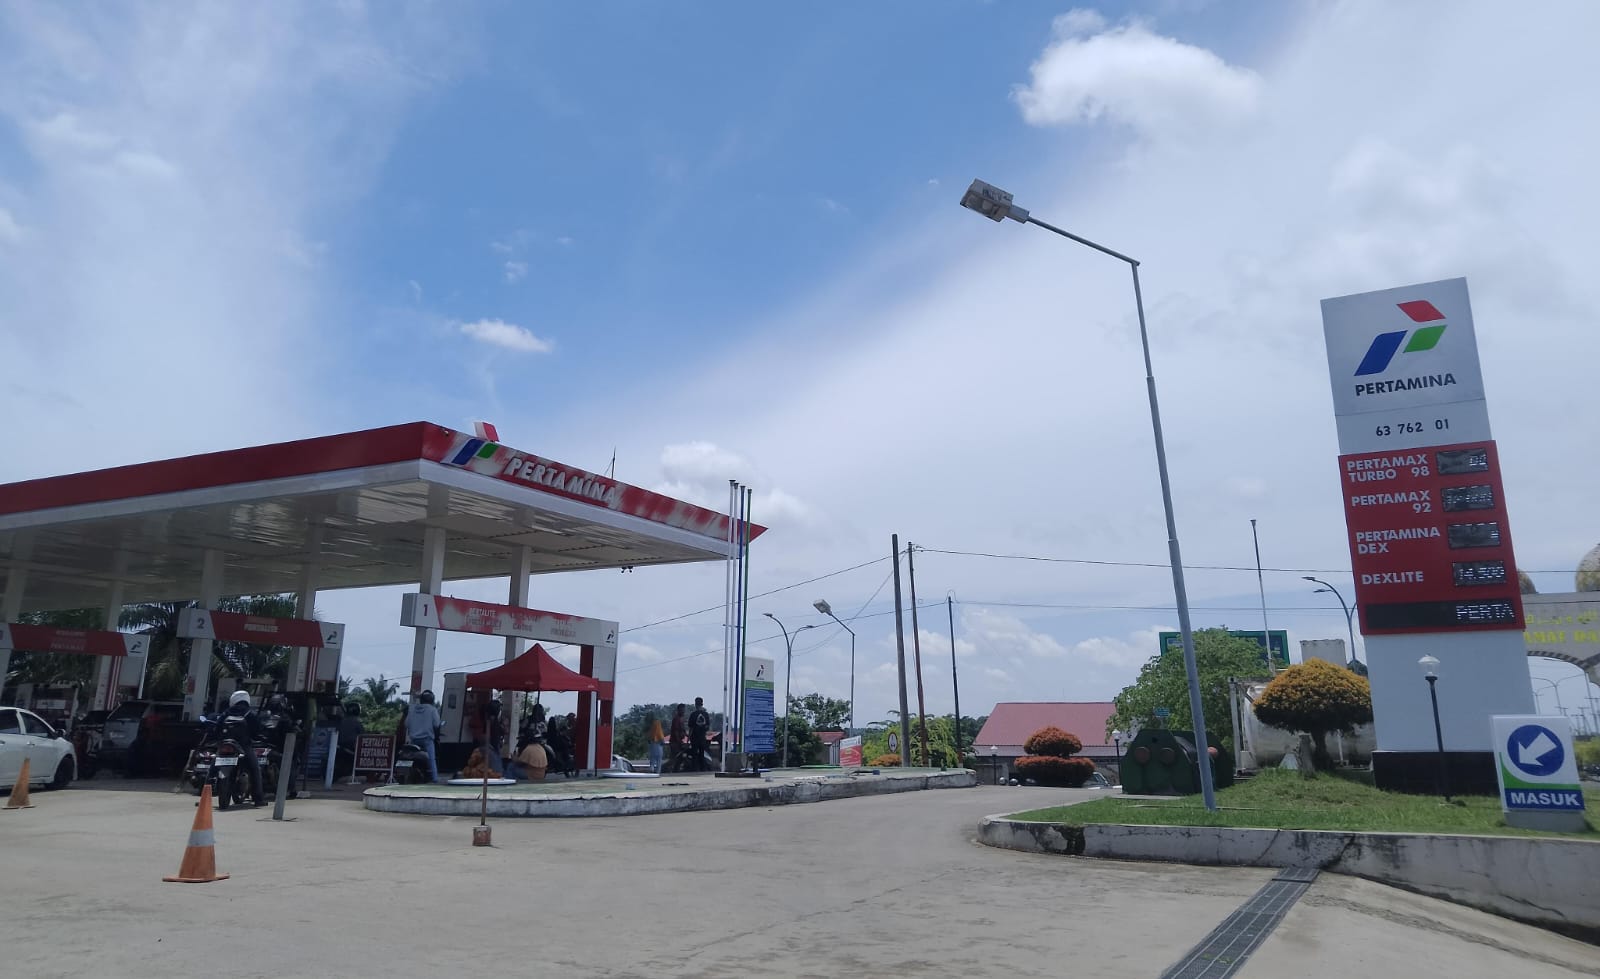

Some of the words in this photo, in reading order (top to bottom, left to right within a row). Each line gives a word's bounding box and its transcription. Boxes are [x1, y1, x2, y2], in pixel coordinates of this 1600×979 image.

[1354, 373, 1457, 397] PERTAMINA
[1375, 425, 1391, 437] 63
[1397, 422, 1424, 435] 762
[1435, 418, 1450, 431] 01
[1347, 454, 1428, 471] PERTAMAX
[504, 456, 616, 504] PERTAMINA
[1348, 468, 1397, 483] TURBO
[1411, 465, 1430, 478] 98
[1351, 490, 1431, 507] PERTAMAX
[1412, 502, 1432, 514] 92
[1356, 527, 1441, 543] PERTAMINA
[1358, 542, 1390, 555] DEX
[1361, 571, 1425, 585] DEXLITE
[423, 603, 428, 617] 1
[197, 618, 205, 630] 2
[1510, 792, 1580, 806] MASUK
